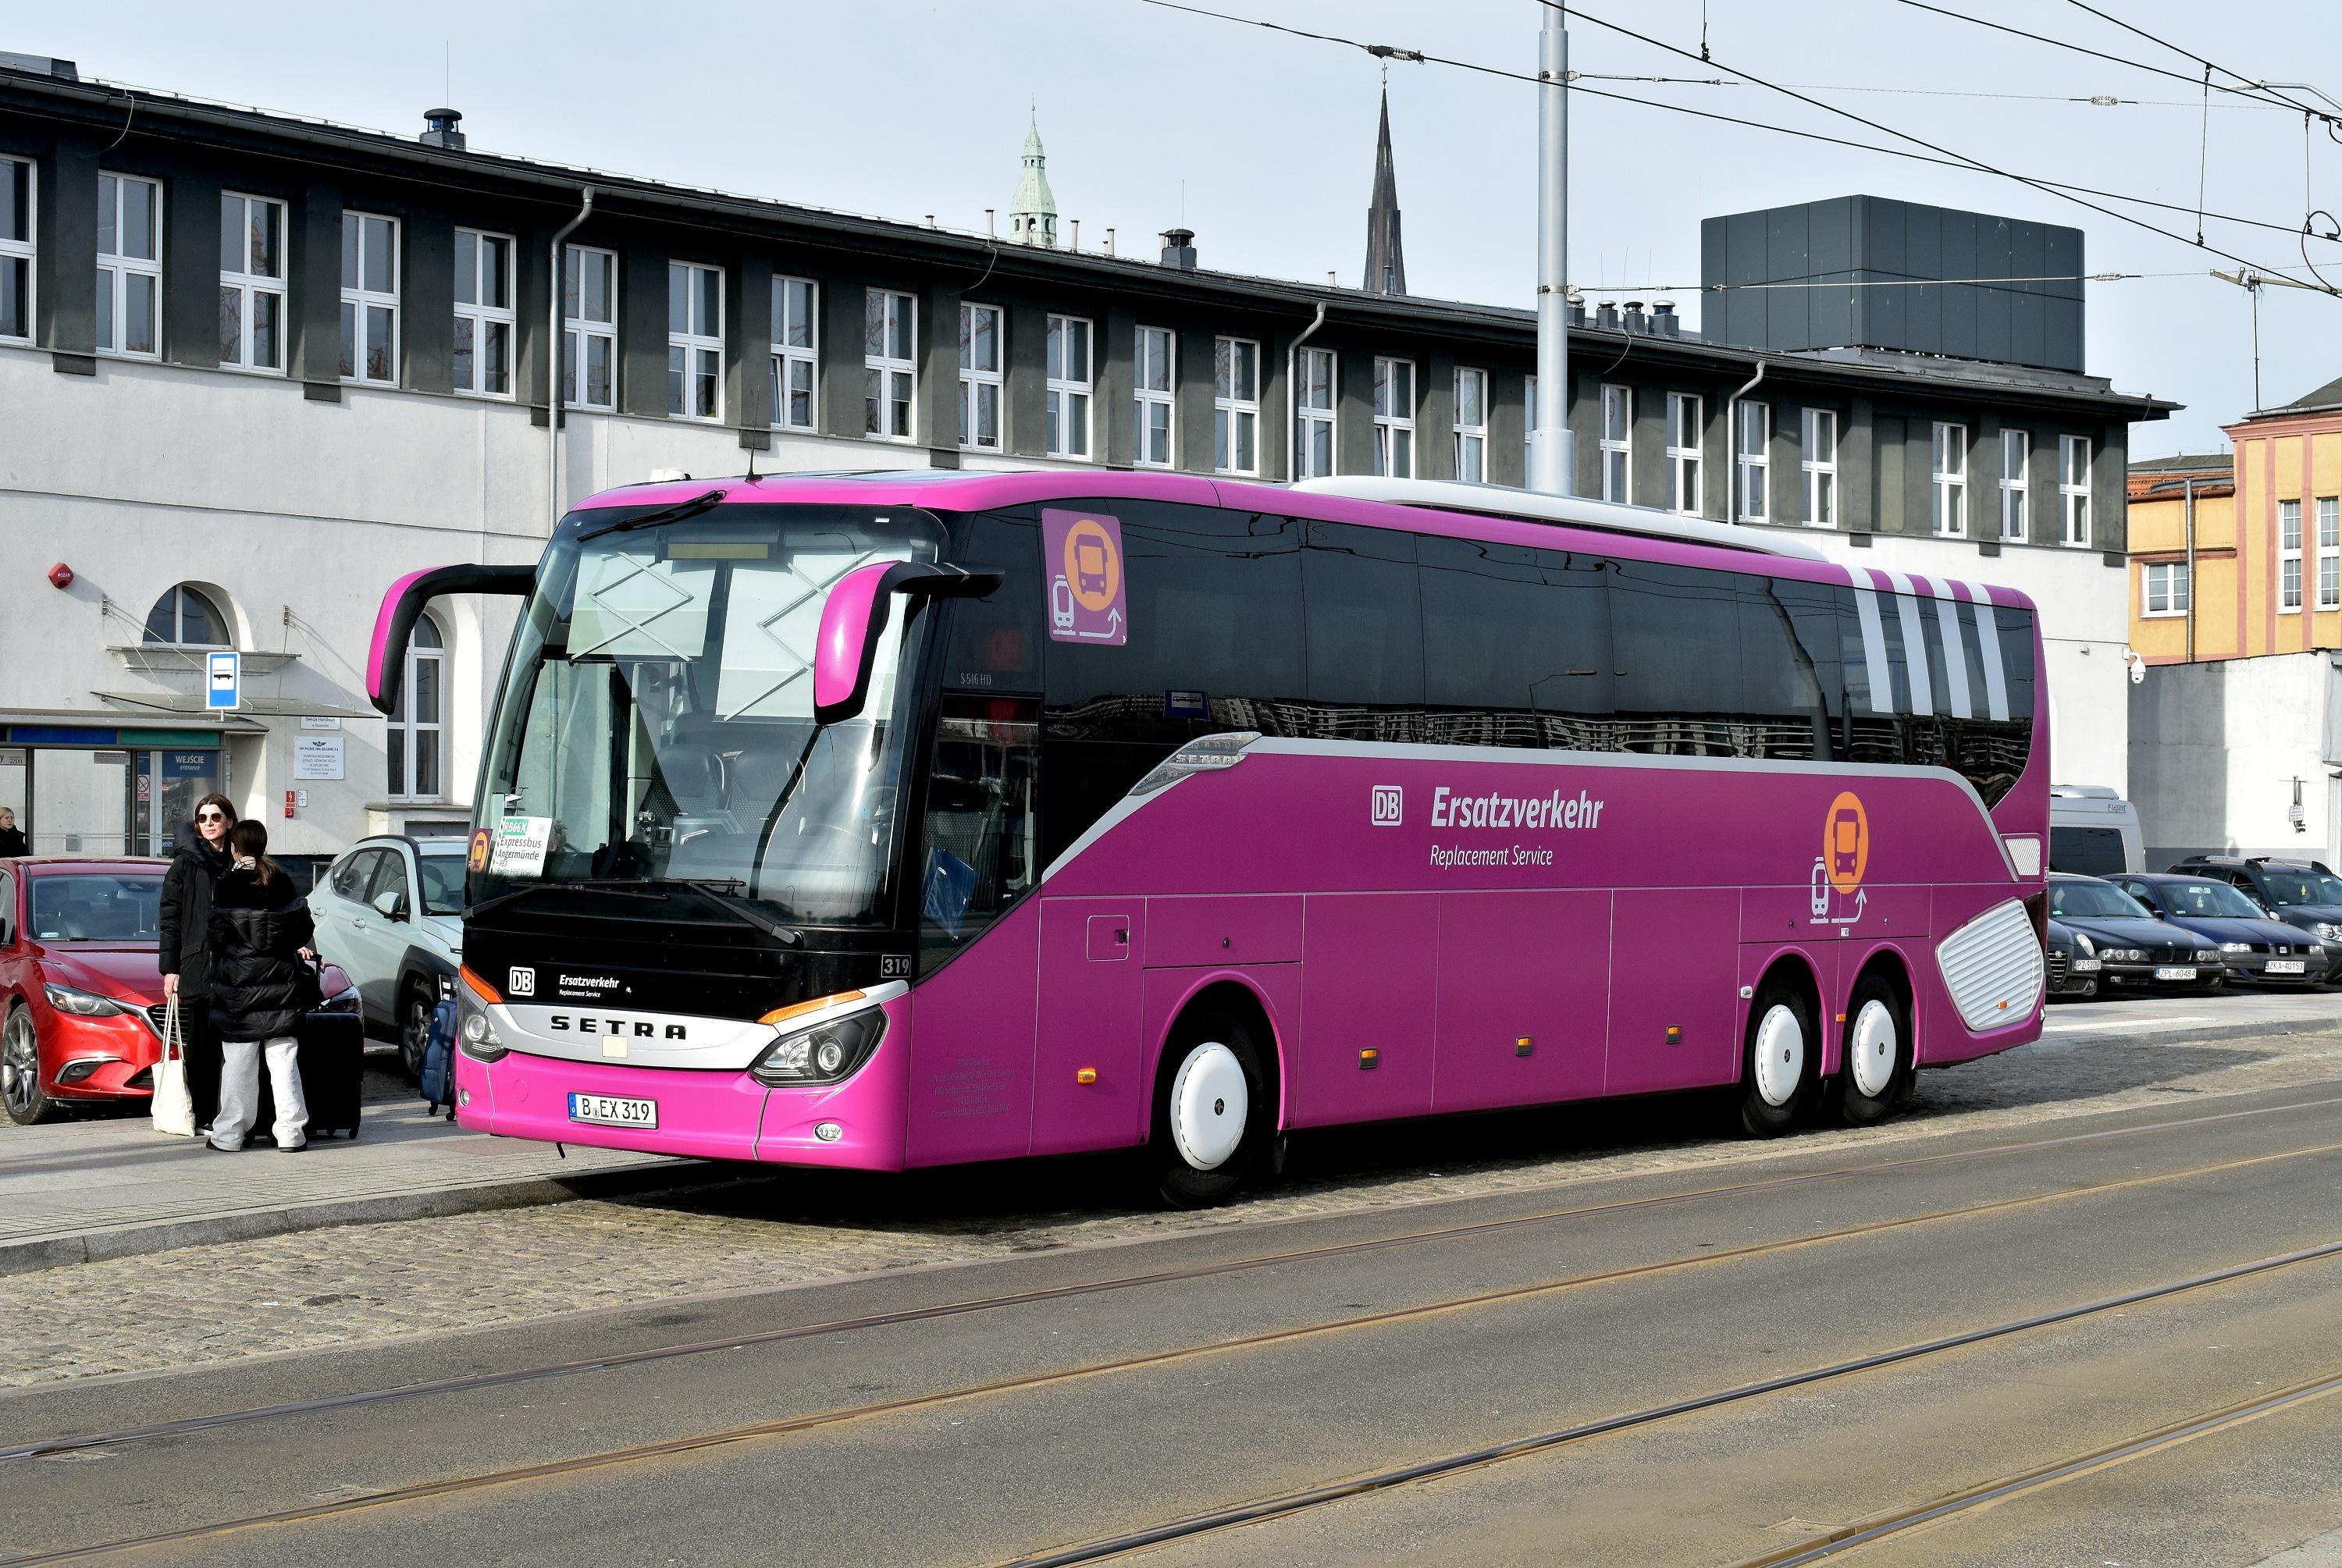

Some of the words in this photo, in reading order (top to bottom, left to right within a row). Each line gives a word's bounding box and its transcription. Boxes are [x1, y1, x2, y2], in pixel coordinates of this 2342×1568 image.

[966, 674, 979, 684] 516
[981, 674, 991, 685] HD
[175, 755, 205, 763] WEJŚCIE
[1176, 754, 1233, 765] SETRA
[1374, 790, 1401, 821] DB
[1431, 787, 1603, 828] Ersatzverkehr
[504, 822, 528, 833] RB66X
[500, 836, 542, 848] Expressbus
[497, 849, 539, 861] Angermünde
[1429, 844, 1509, 870] Replacement
[1511, 844, 1553, 866] Service
[884, 958, 909, 973] 319
[2160, 969, 2173, 977] ZPL
[2175, 969, 2196, 978] 60484
[511, 970, 532, 993] DB
[559, 974, 619, 988] Ersatzverkehr
[551, 1015, 686, 1040] SETRA
[582, 1098, 591, 1115] B
[600, 1100, 618, 1118] EX
[622, 1101, 650, 1121] 319
